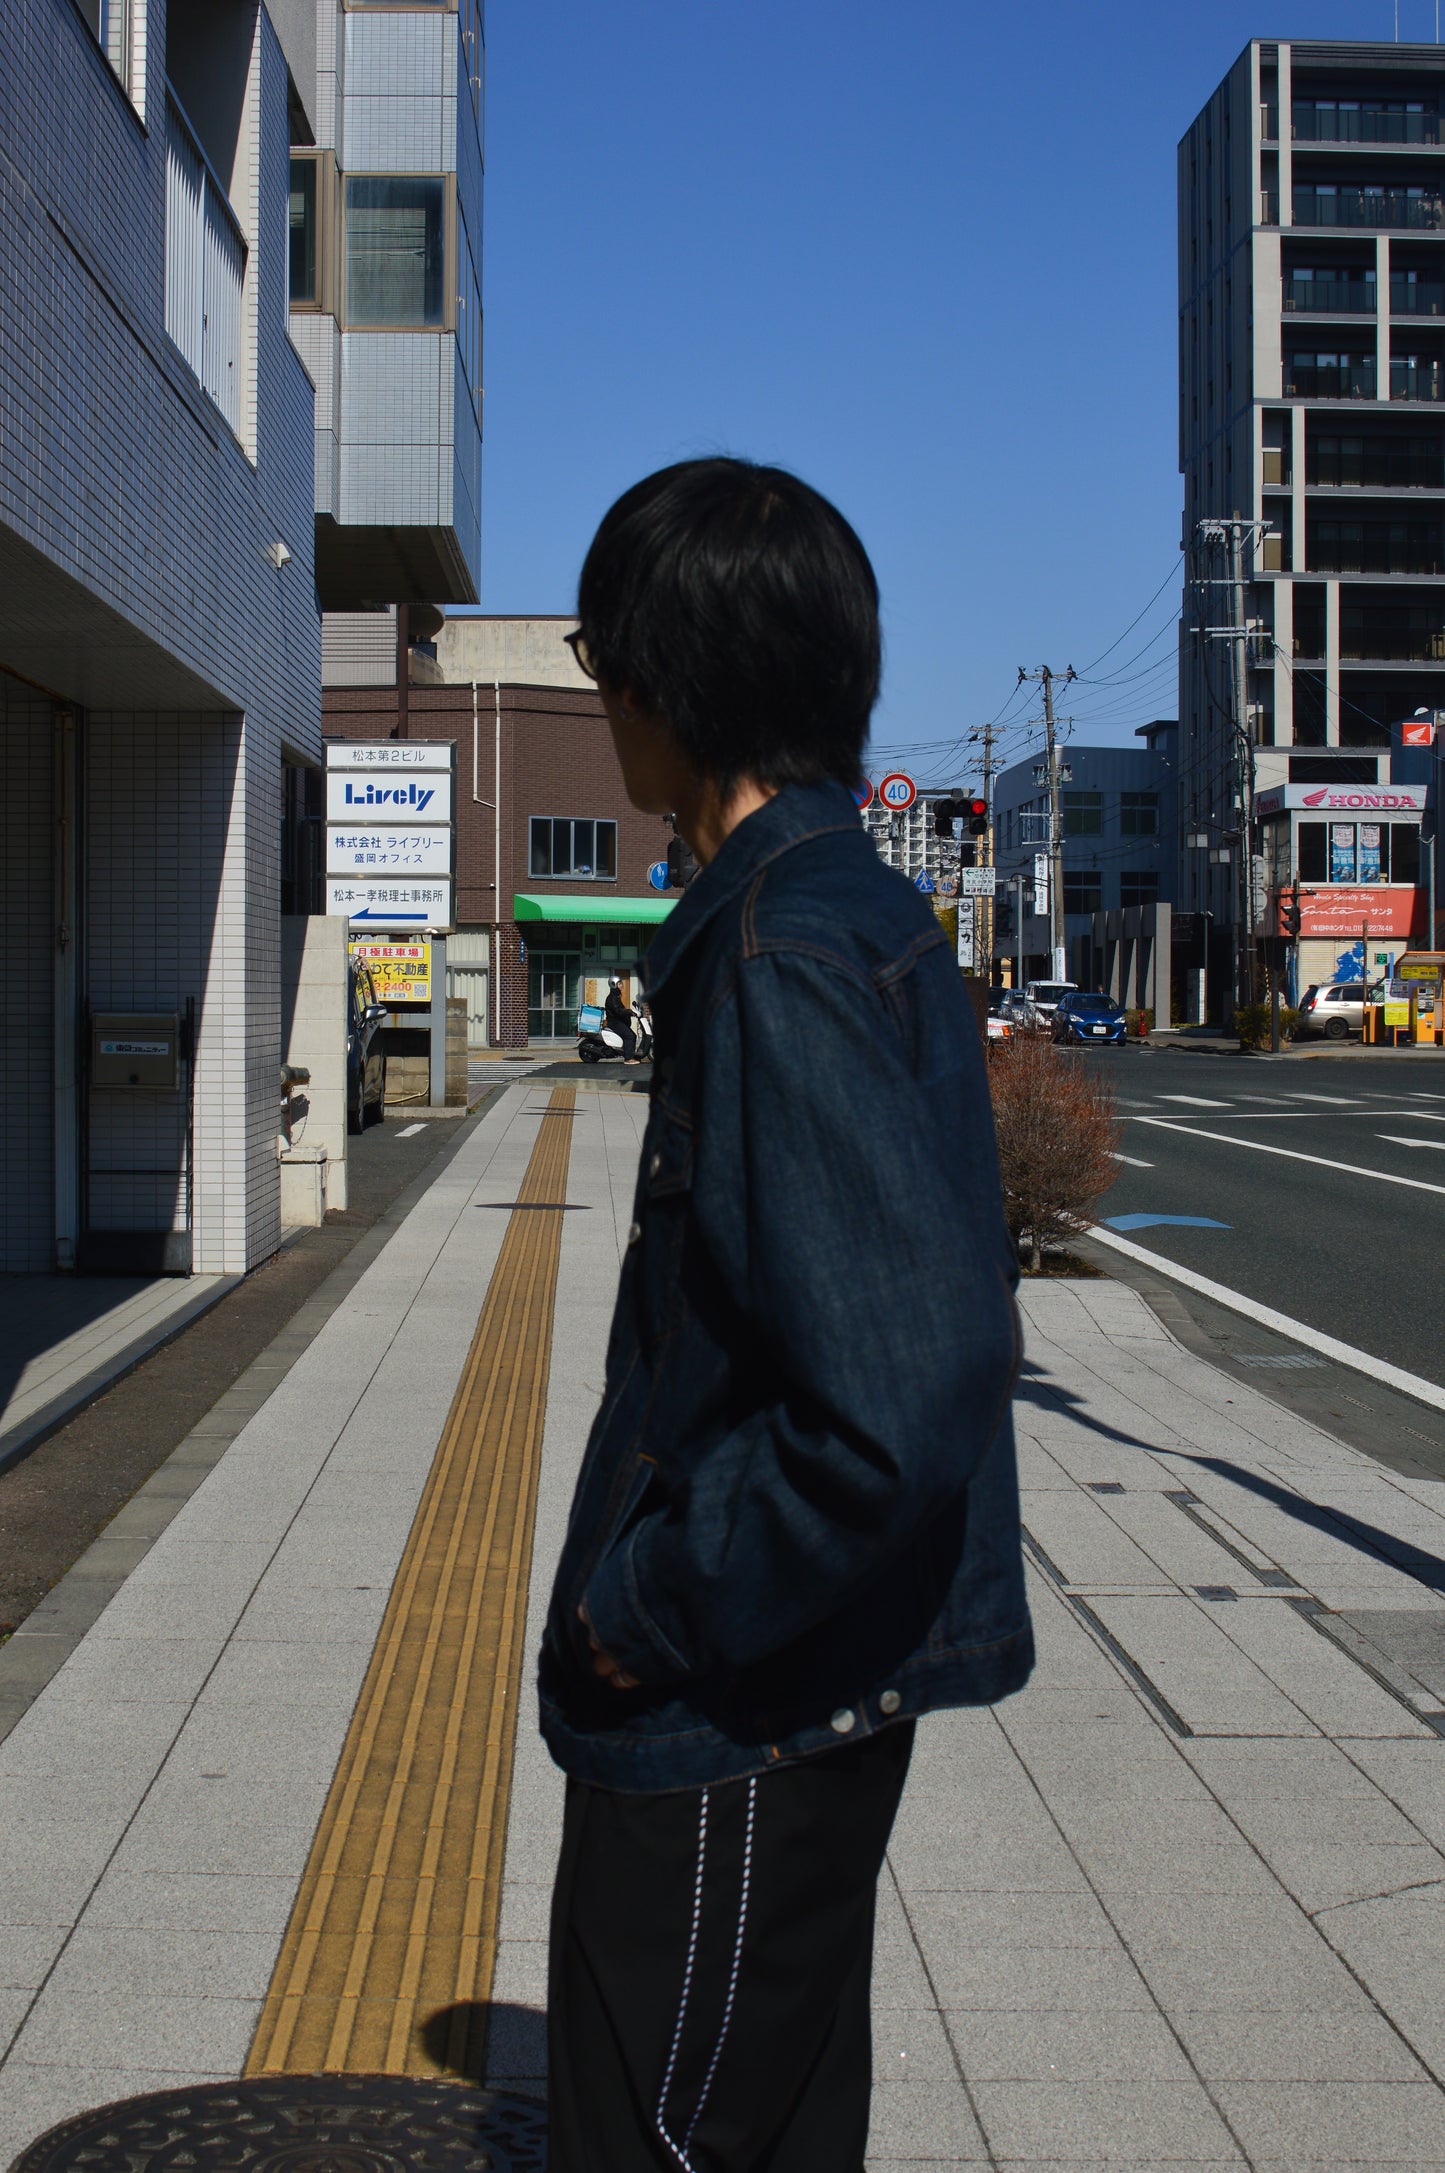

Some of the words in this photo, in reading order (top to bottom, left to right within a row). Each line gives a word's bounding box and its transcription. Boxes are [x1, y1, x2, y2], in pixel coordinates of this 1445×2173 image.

[352, 750, 425, 762] 松本第2ビル
[345, 783, 436, 811] Lively
[887, 784, 908, 800] 40
[1328, 794, 1418, 808] HONDA
[334, 836, 382, 849] 株式会社
[386, 836, 444, 849] ライブリー
[354, 853, 423, 864] 盛岡オフィス
[941, 882, 953, 891] 40
[333, 889, 444, 903] 松本一孝税理士事務所
[1360, 893, 1375, 902] Shop
[358, 947, 419, 957] 月極駐車場
